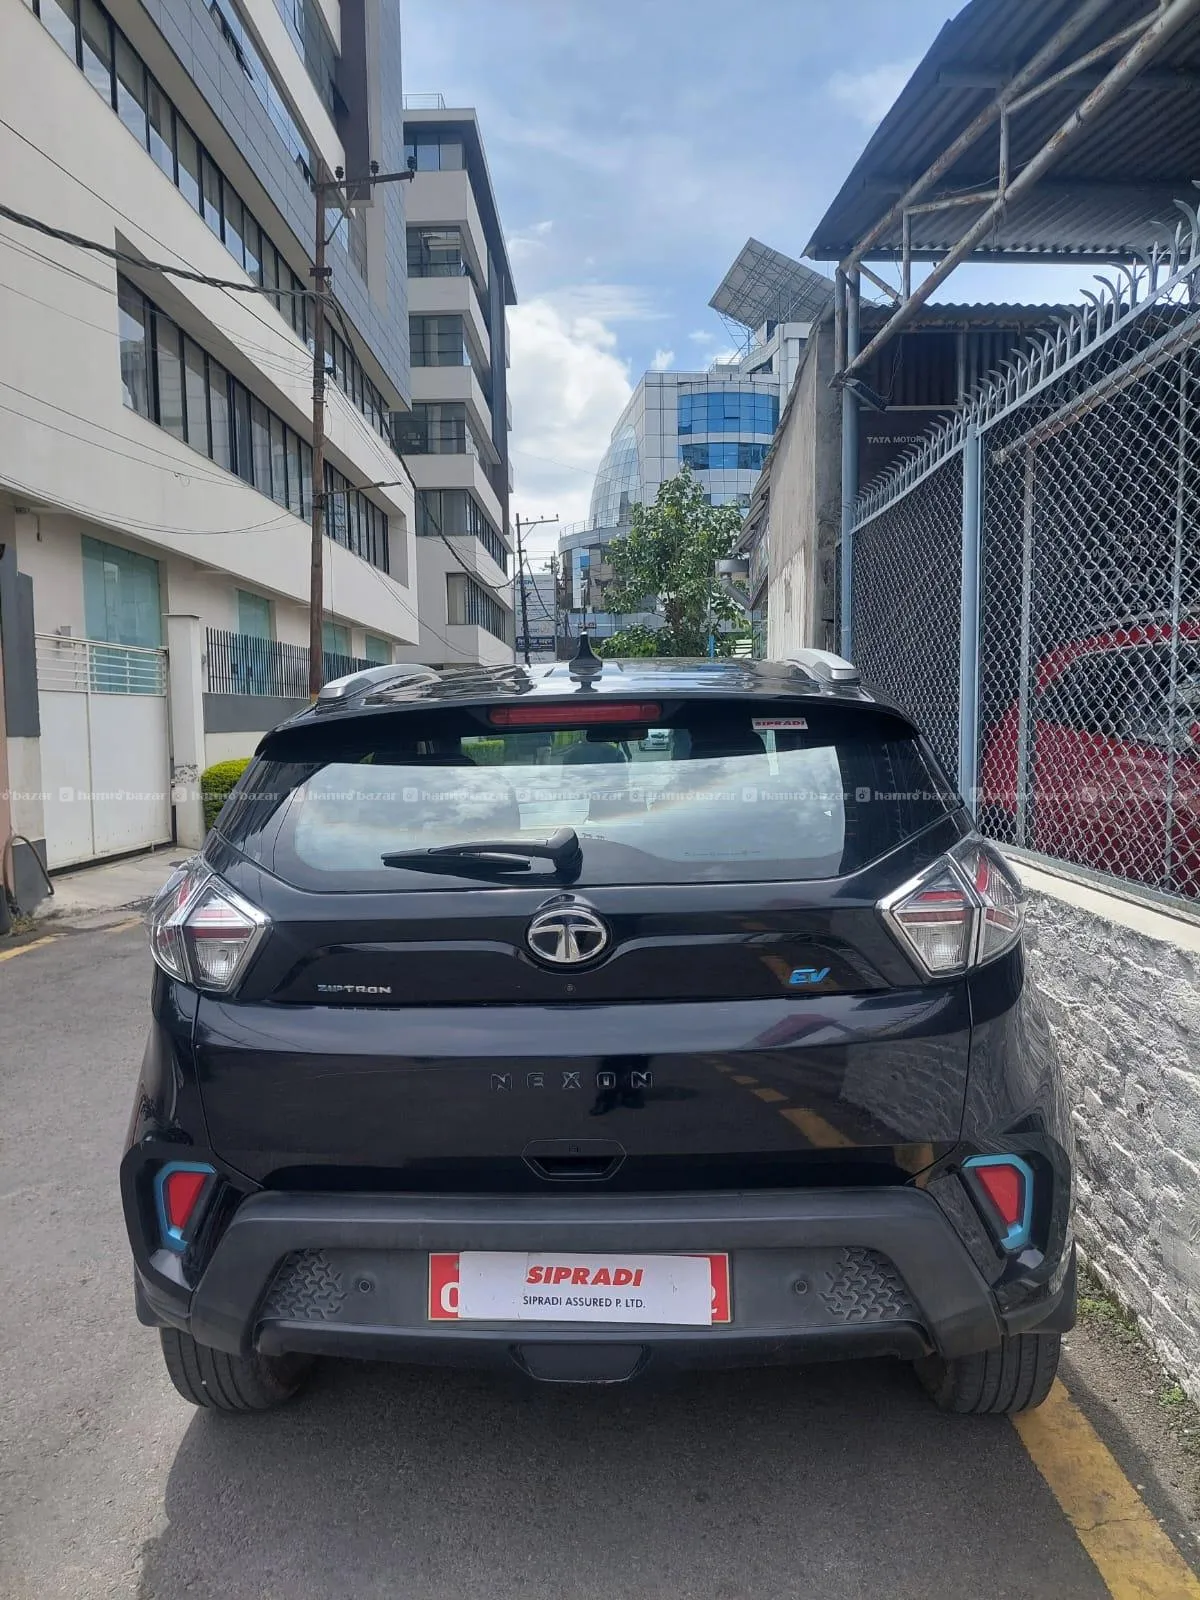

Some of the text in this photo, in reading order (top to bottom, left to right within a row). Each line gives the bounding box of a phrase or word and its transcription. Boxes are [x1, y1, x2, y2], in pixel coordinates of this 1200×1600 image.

[893, 435, 926, 443] MOTOR
[789, 967, 831, 984] EV
[317, 984, 392, 994] ZIPTRON
[490, 1071, 653, 1089] NEXON
[526, 1266, 643, 1286] SIPRADI
[523, 1295, 646, 1308] SIPRADI ASSURED P. LTD.
